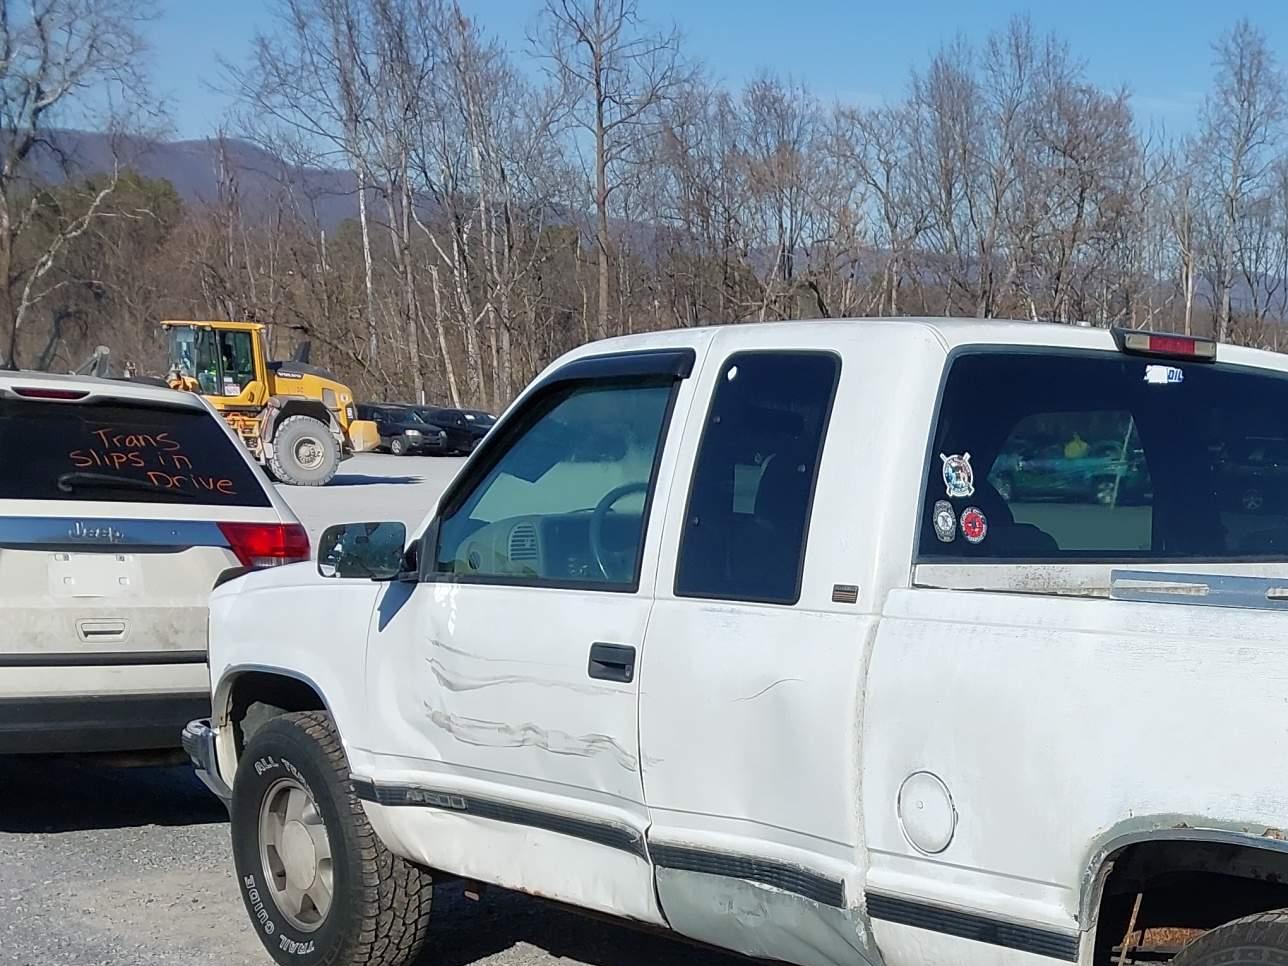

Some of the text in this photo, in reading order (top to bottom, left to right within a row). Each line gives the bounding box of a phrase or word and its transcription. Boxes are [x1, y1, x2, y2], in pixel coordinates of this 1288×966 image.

[92, 428, 180, 450] Trans
[69, 449, 193, 470] Slips in
[147, 471, 237, 495] Drive
[254, 755, 280, 776] ALL
[243, 875, 315, 956] TRAIL GUIDE
